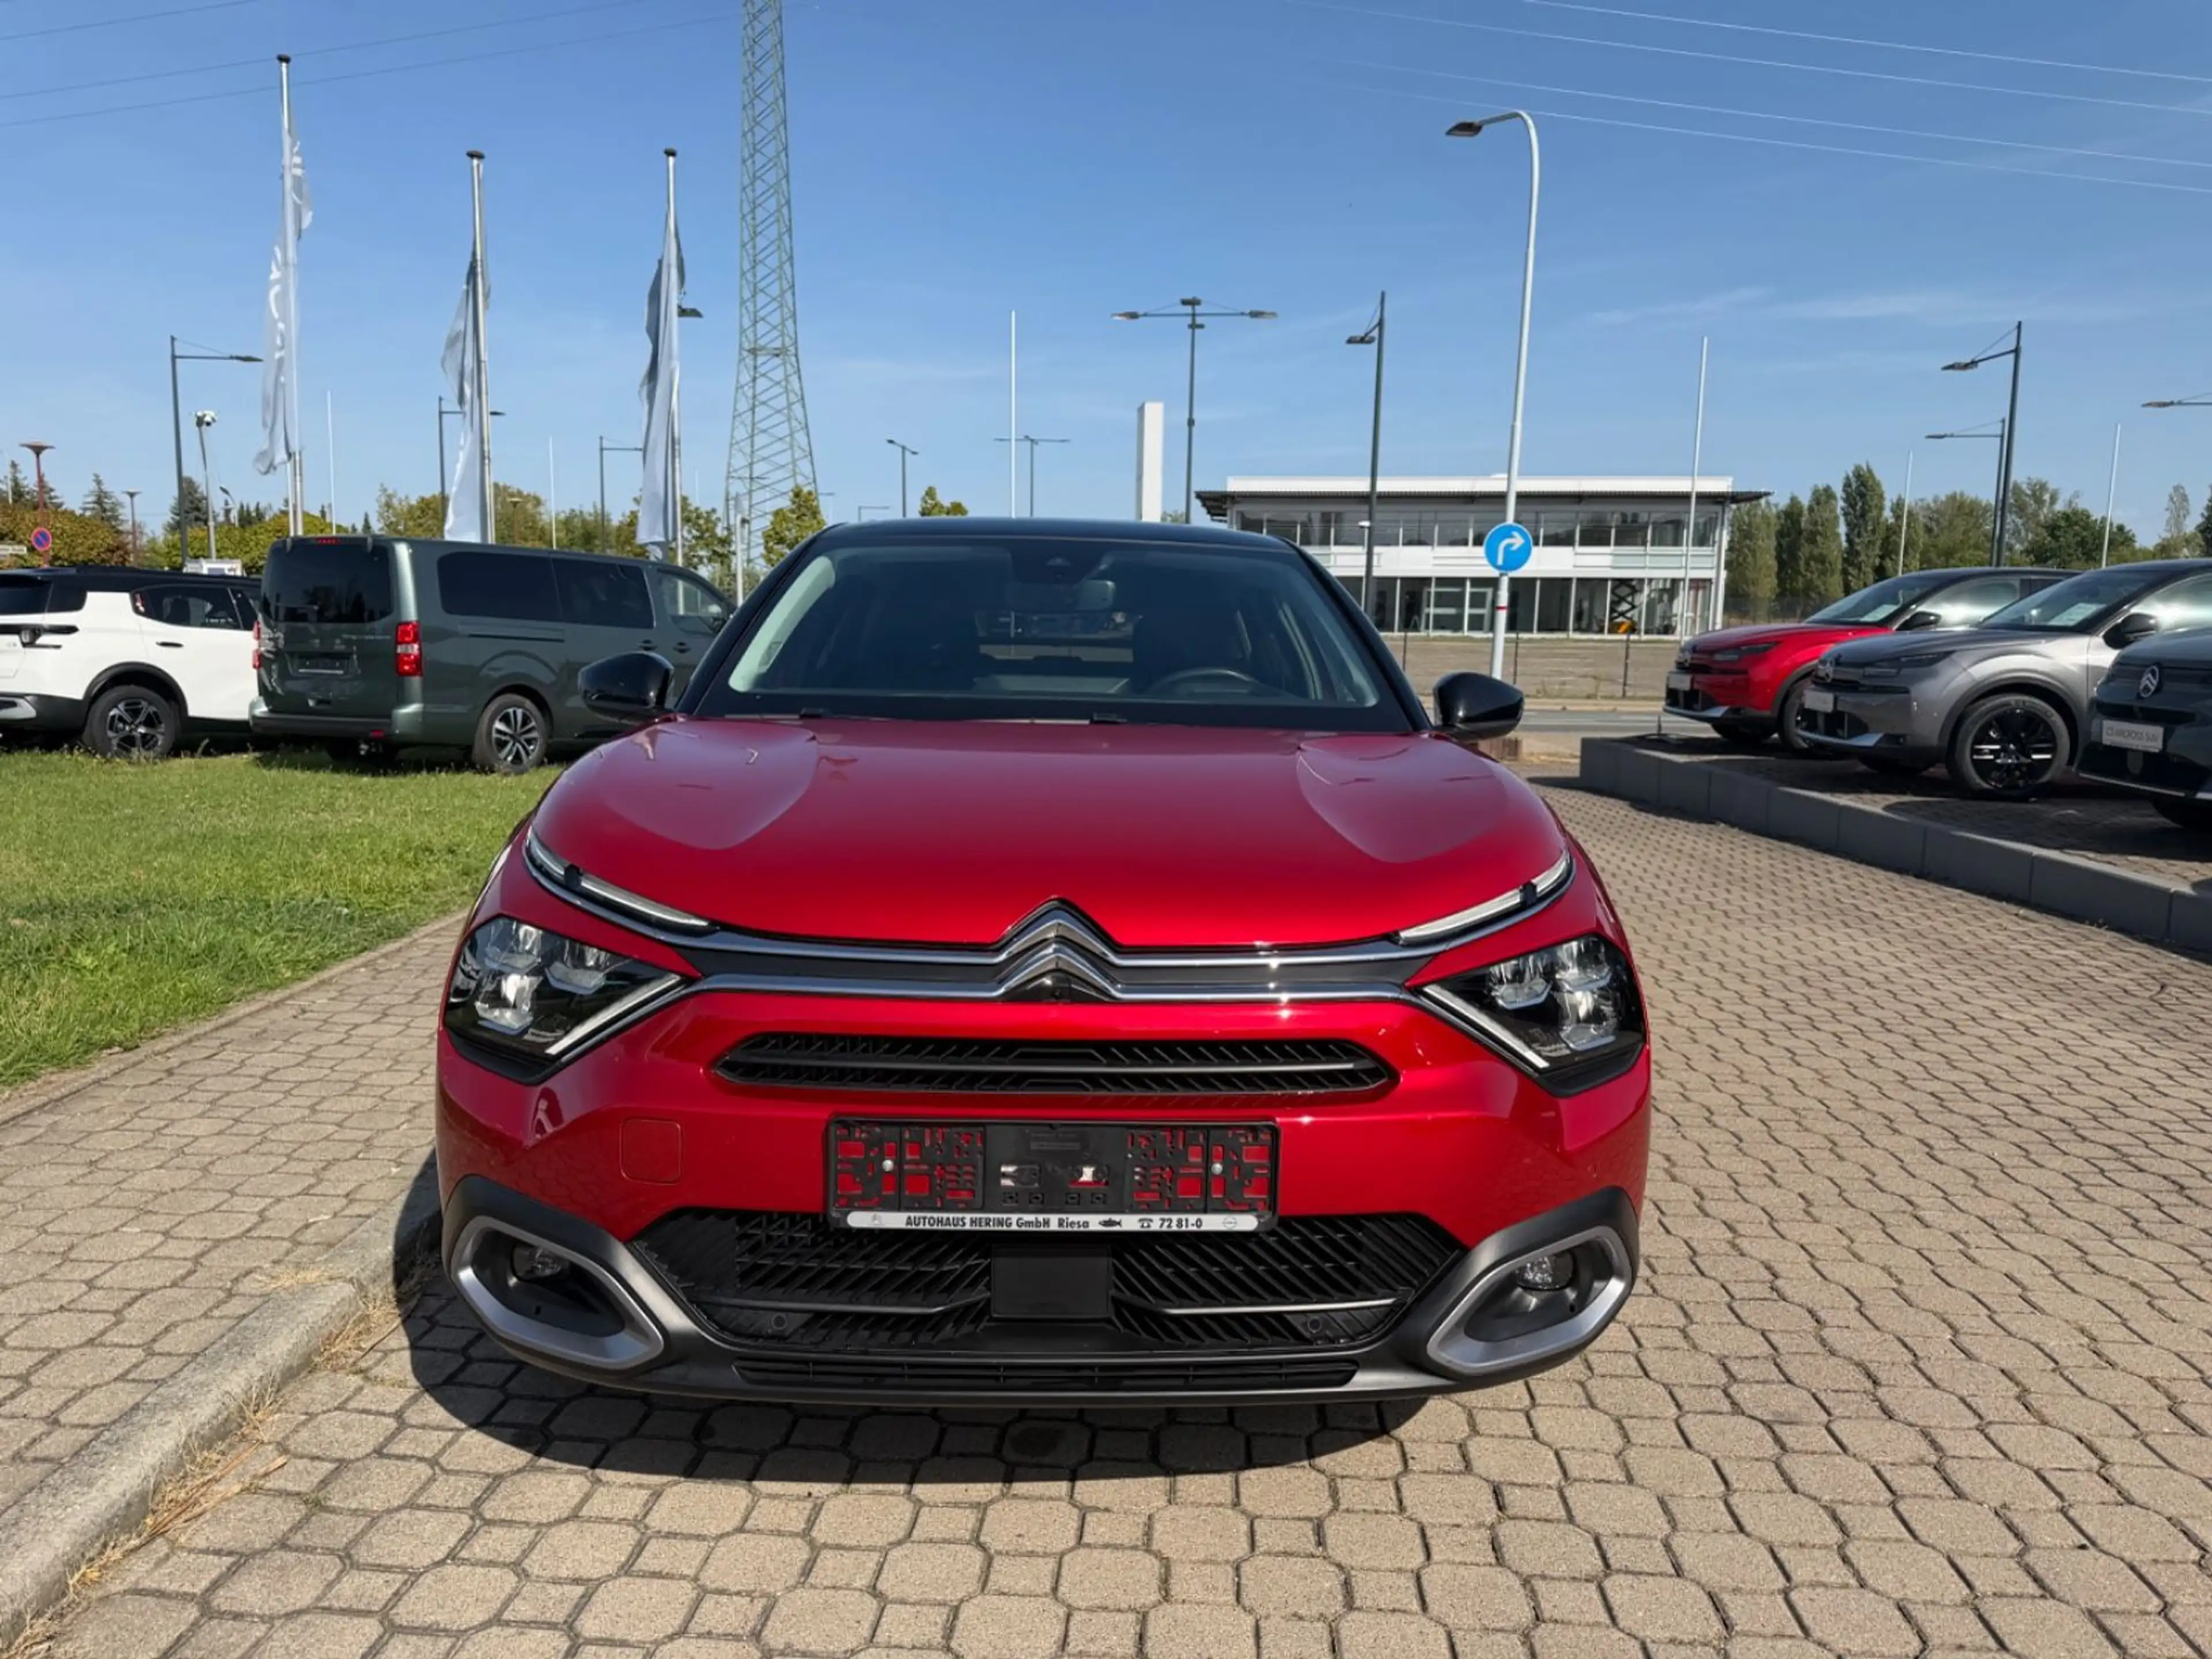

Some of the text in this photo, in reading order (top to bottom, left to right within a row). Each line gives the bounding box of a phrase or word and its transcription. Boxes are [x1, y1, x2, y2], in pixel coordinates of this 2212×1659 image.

[906, 1215, 966, 1228] AUTOHAUS
[969, 1216, 1012, 1228] HERING
[1016, 1216, 1050, 1228] GmbH
[1058, 1217, 1090, 1229] Riesa
